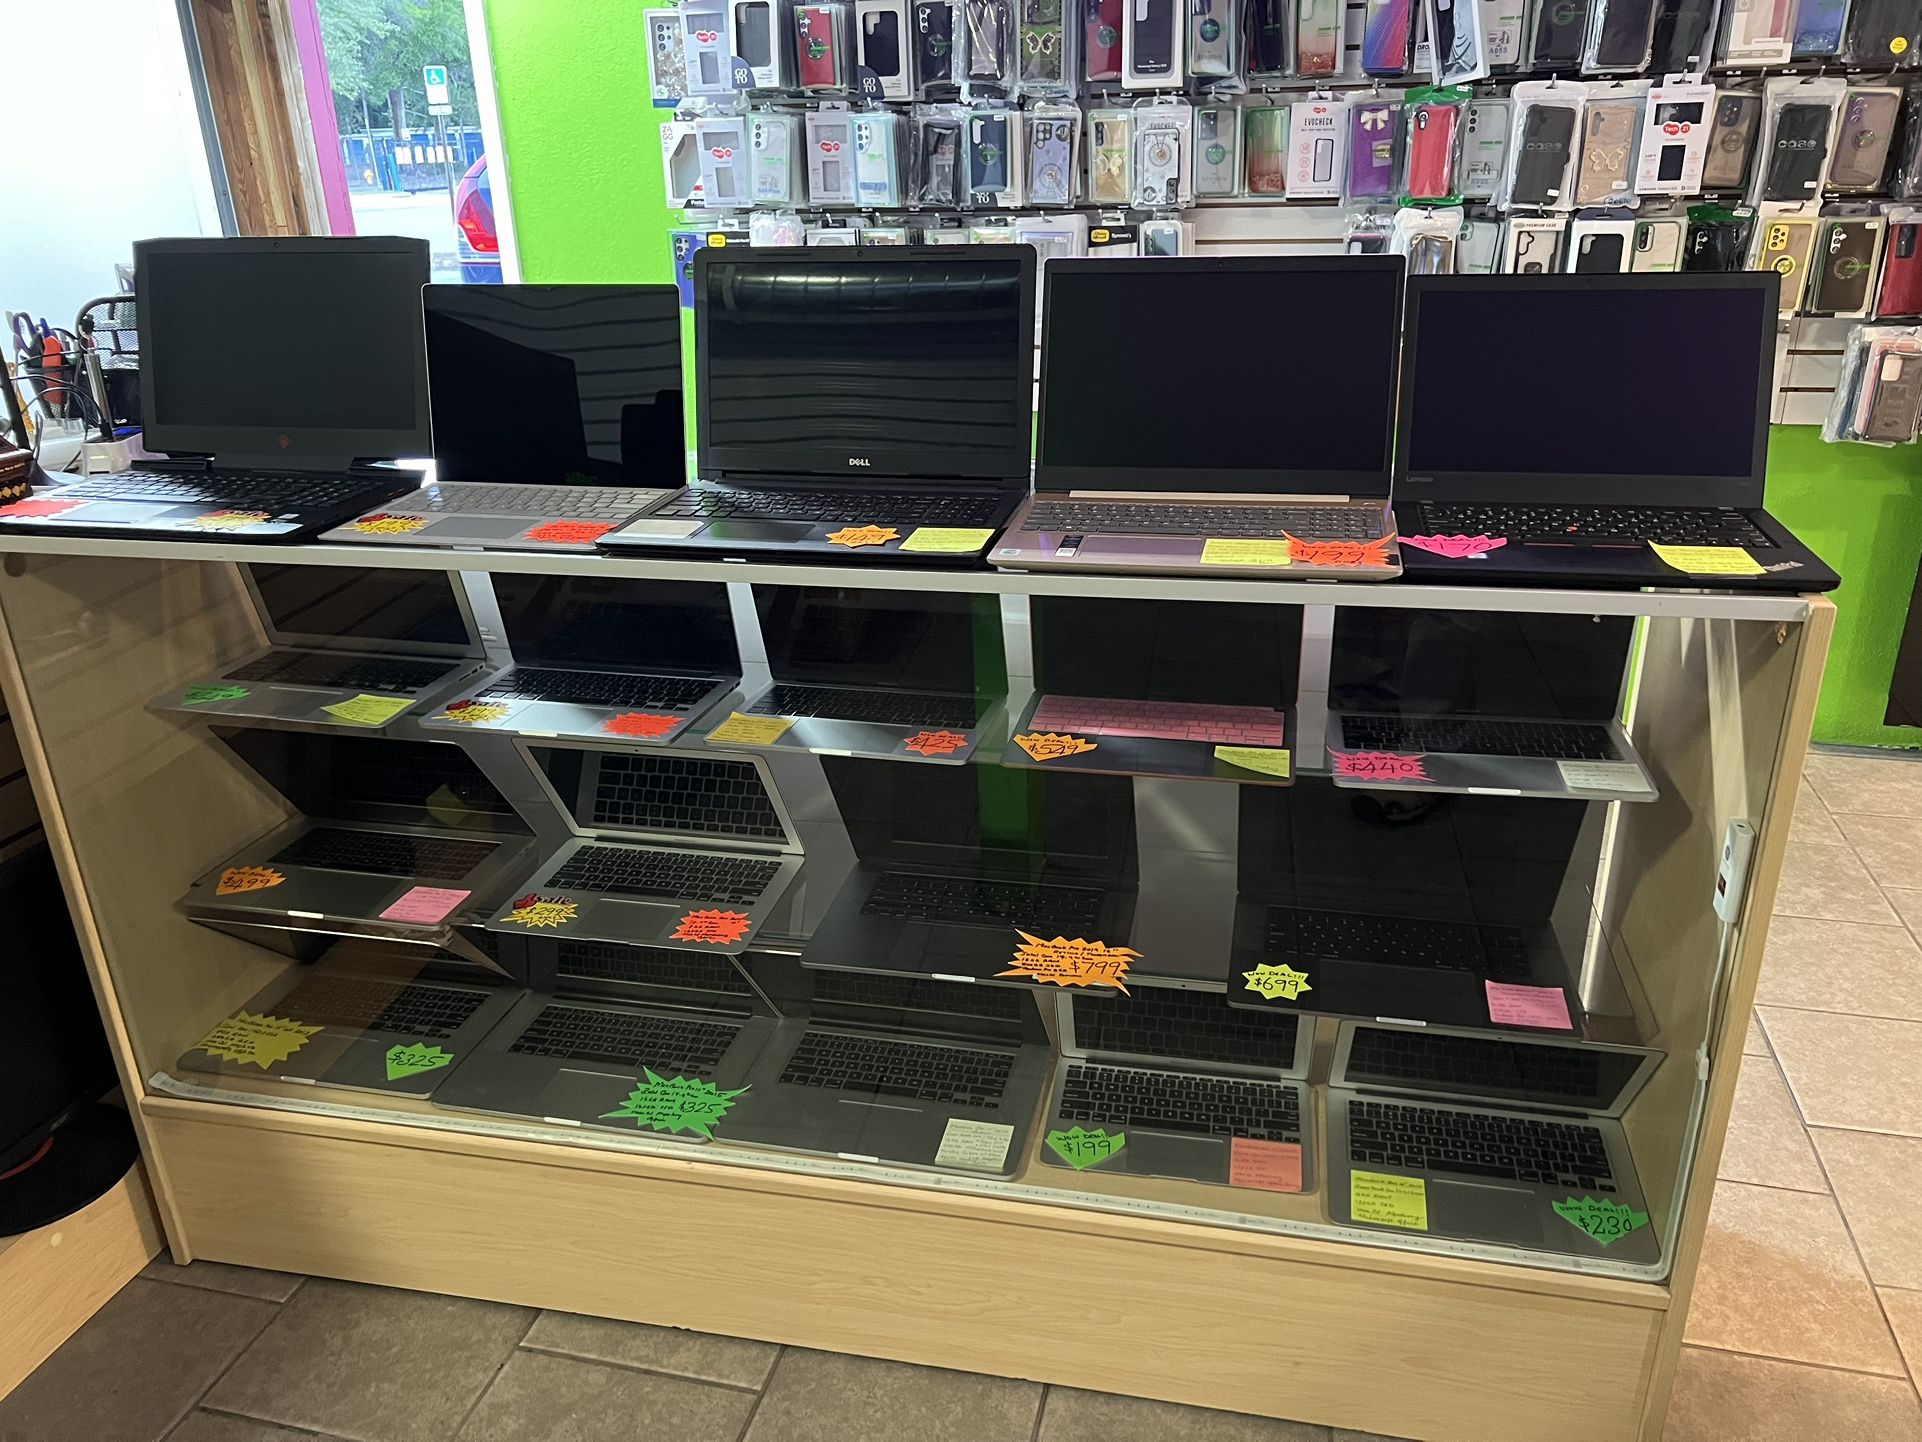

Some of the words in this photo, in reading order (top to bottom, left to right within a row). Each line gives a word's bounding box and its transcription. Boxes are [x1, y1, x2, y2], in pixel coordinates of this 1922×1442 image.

[736, 76, 748, 84] TO
[864, 85, 876, 93] TO
[1304, 118, 1333, 126] EVOCHECK
[1663, 124, 1680, 134] Tech
[1682, 124, 1690, 132] 21
[1778, 140, 1816, 148] case
[1028, 743, 1079, 755] $549
[1346, 761, 1414, 773] $440
[1069, 960, 1121, 976] $799
[1254, 976, 1298, 992] $699
[388, 1050, 445, 1067] $325
[678, 1101, 722, 1114] $325
[1064, 1140, 1111, 1157] $199
[1578, 1215, 1632, 1235] $230
